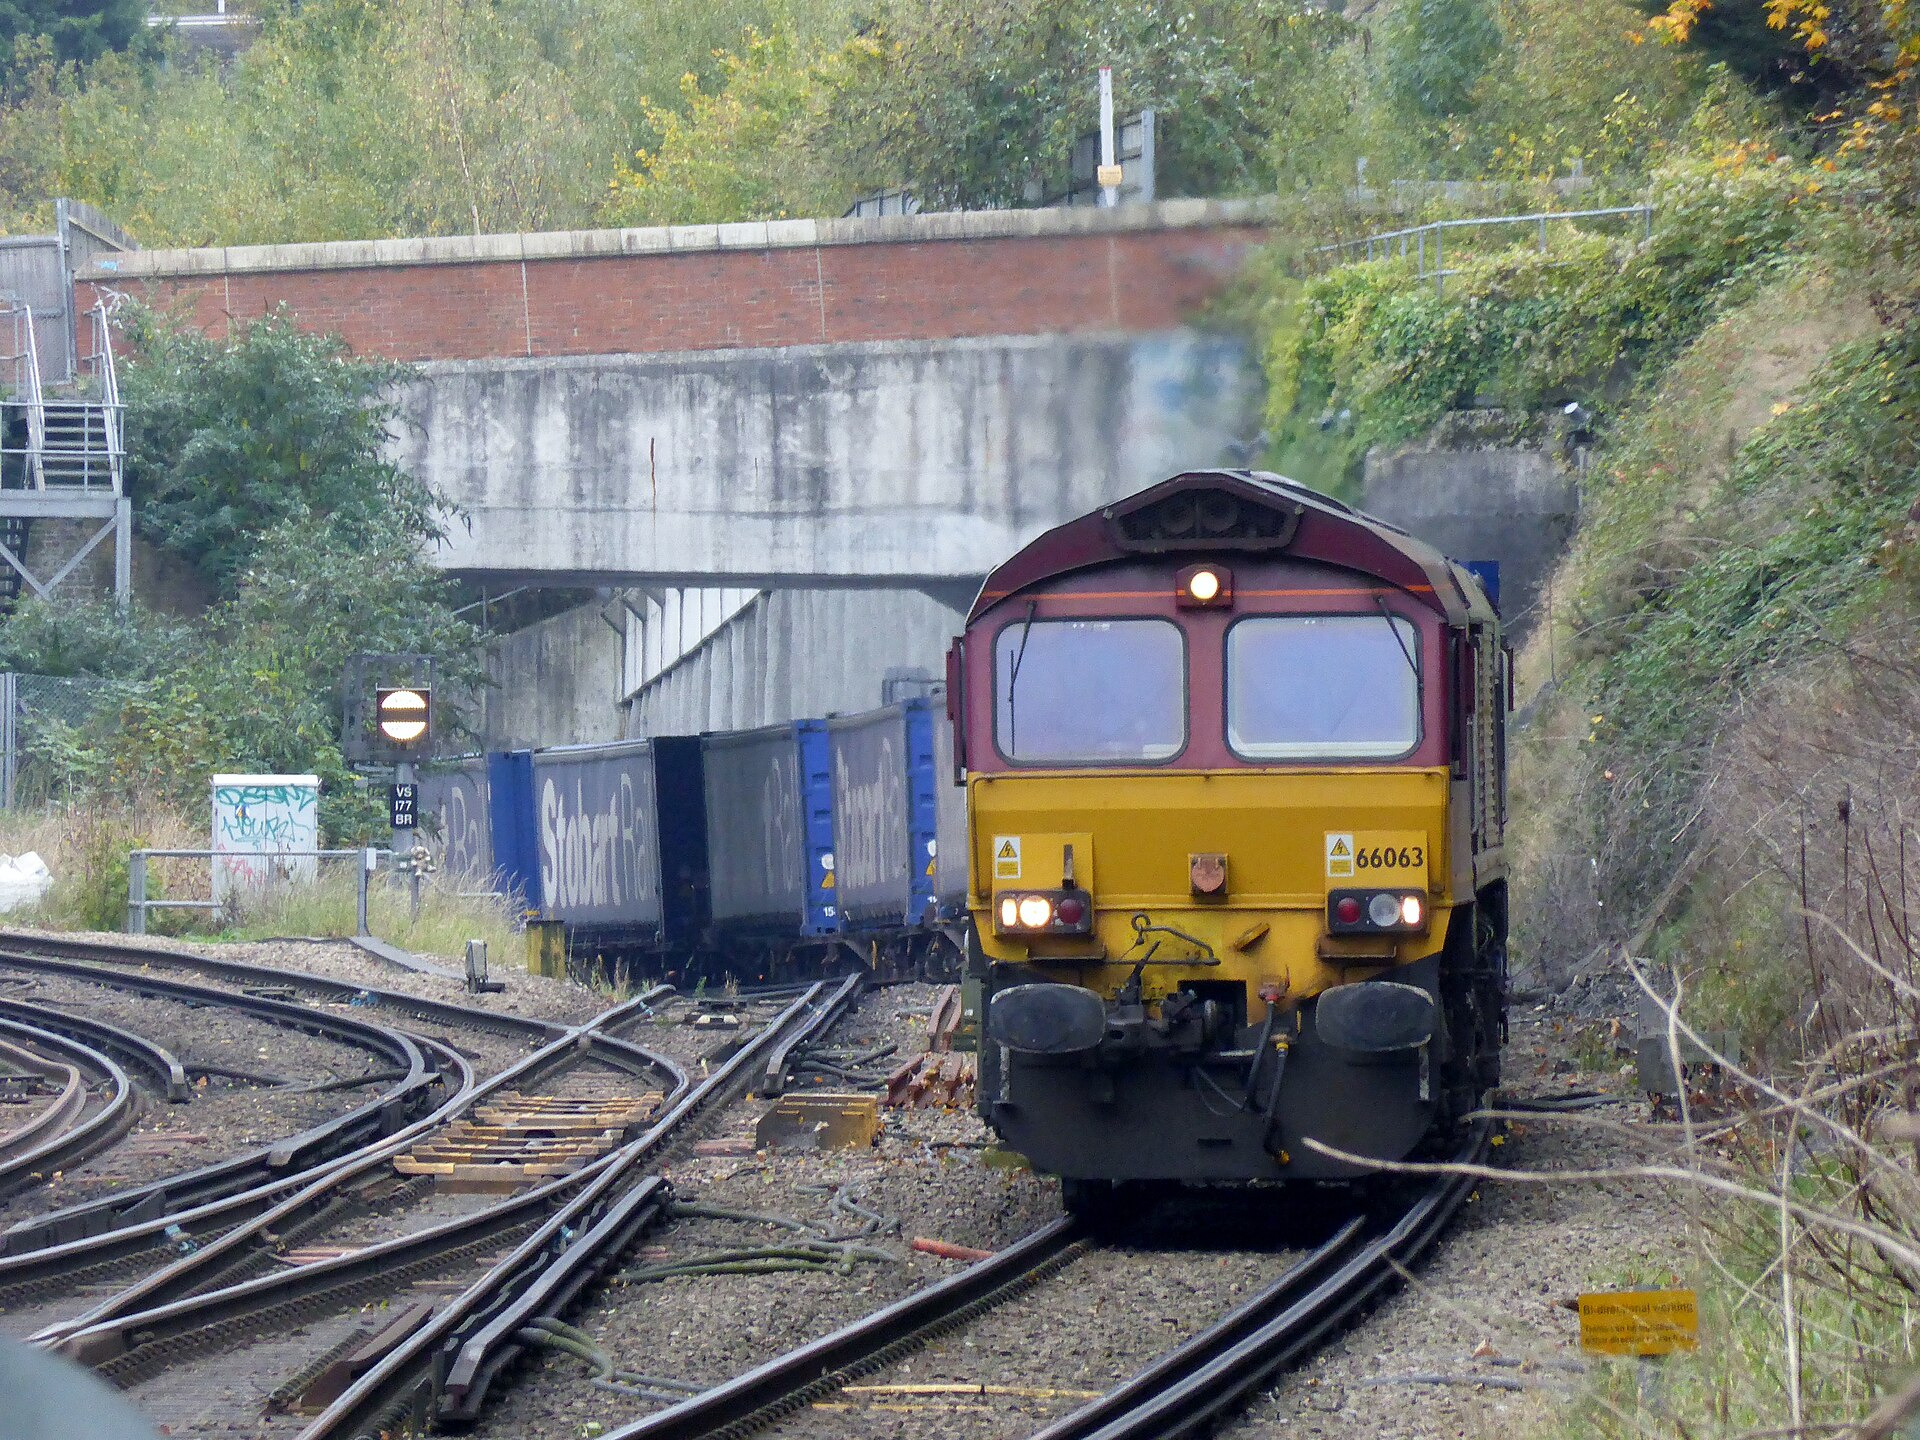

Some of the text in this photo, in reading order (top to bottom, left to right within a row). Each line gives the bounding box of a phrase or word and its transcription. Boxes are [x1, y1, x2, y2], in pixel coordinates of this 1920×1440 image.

[396, 784, 412, 798] VS
[395, 800, 413, 811] 177
[395, 813, 413, 825] BR
[541, 777, 621, 909] Stobart
[1356, 846, 1424, 869] 66063
